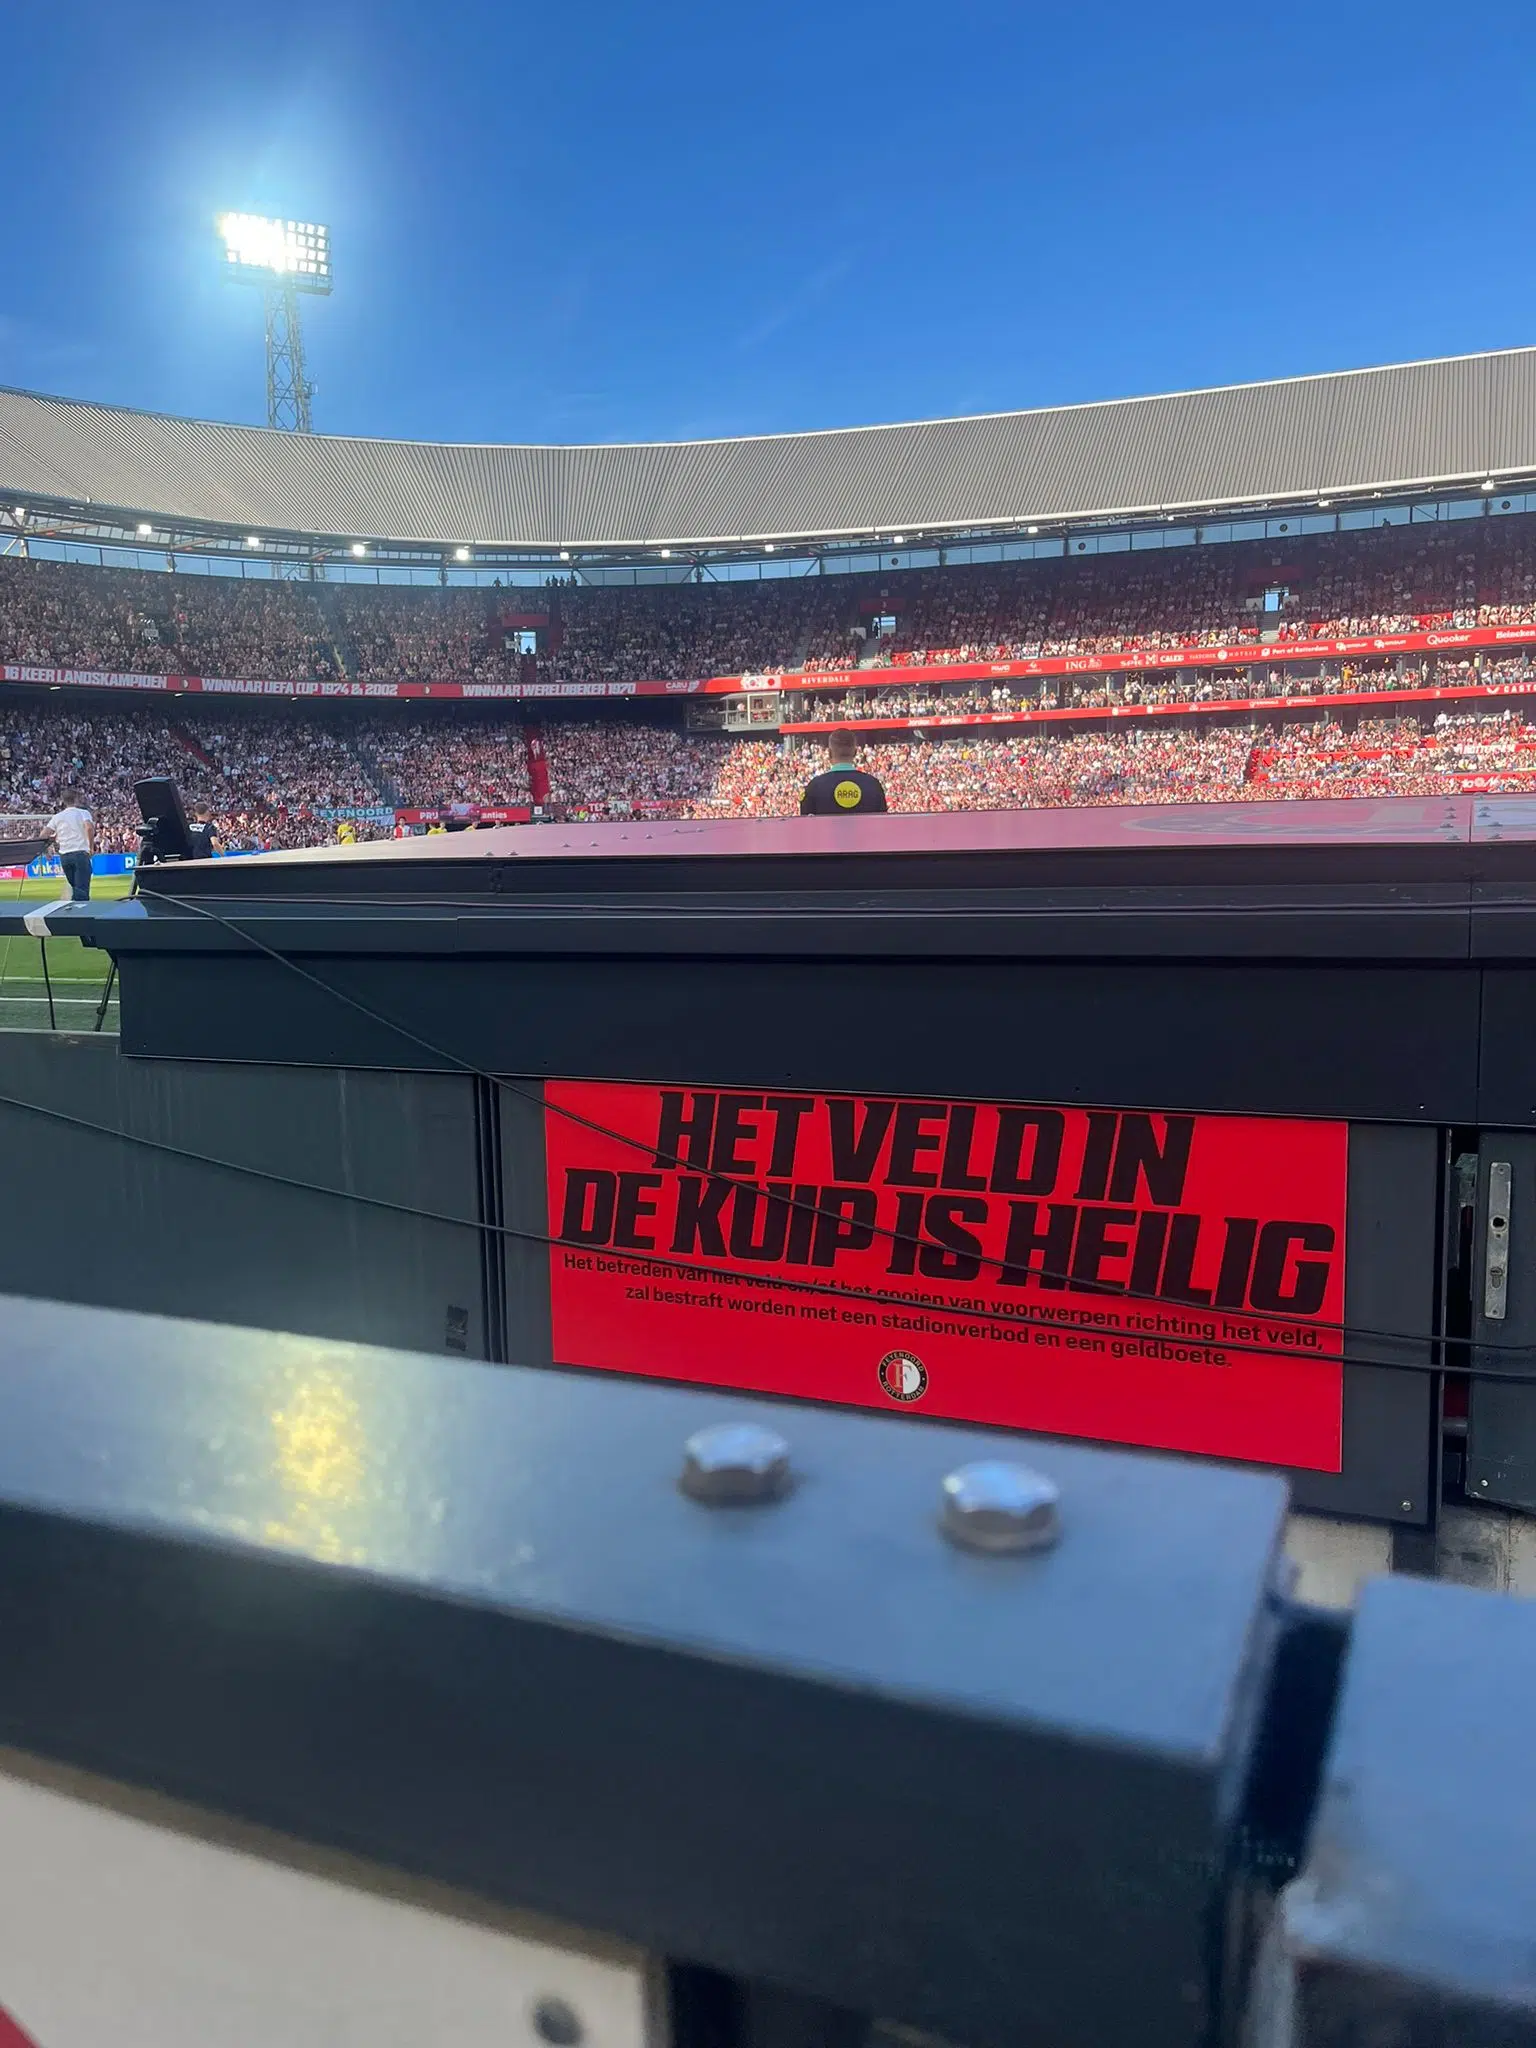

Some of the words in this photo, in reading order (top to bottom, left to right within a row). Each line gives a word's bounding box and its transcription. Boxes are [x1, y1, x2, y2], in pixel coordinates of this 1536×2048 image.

[1426, 634, 1472, 645] Quooker
[1495, 630, 1536, 639] Heineken
[1065, 661, 1087, 671] ING
[3, 666, 19, 680] 16
[20, 667, 56, 682] KEER
[56, 669, 168, 689] LANDSKAMPIOEN
[200, 678, 263, 694] WINNAAR
[264, 681, 295, 694] UEFA
[295, 682, 319, 695] CUP
[320, 682, 350, 696] 1974
[365, 683, 398, 696] 2002
[801, 675, 850, 685] RIVERDALE
[462, 684, 521, 697] WINNAAR
[522, 683, 606, 697] WERELDBEKER
[607, 682, 637, 695] 1970
[836, 789, 860, 799] ARAG
[651, 1090, 816, 1178] HET
[825, 1098, 1066, 1197] VELD
[1072, 1111, 1196, 1207] IN
[560, 1167, 664, 1251] DE
[669, 1175, 878, 1268] KUIP
[886, 1191, 989, 1282] IS
[995, 1200, 1336, 1315] HEILIG
[564, 1252, 593, 1271] Het
[596, 1257, 673, 1280] betreden
[676, 1265, 708, 1283] van
[948, 1295, 985, 1312] van
[990, 1301, 1121, 1328] voorwerpen
[1126, 1312, 1216, 1341] richting
[1222, 1319, 1262, 1343] het
[1267, 1328, 1324, 1351] veld,
[625, 1285, 650, 1301] zal
[653, 1286, 724, 1309] bestraft
[728, 1296, 796, 1318] worden
[800, 1303, 838, 1322] met
[841, 1310, 877, 1326] een
[881, 1312, 1030, 1344] stadionverbod
[1034, 1332, 1060, 1348] en
[1065, 1335, 1105, 1353] een
[1110, 1338, 1233, 1368] geldboete.
[882, 1351, 925, 1372] FEYENOORD
[882, 1380, 925, 1401] ROTTERDAM
